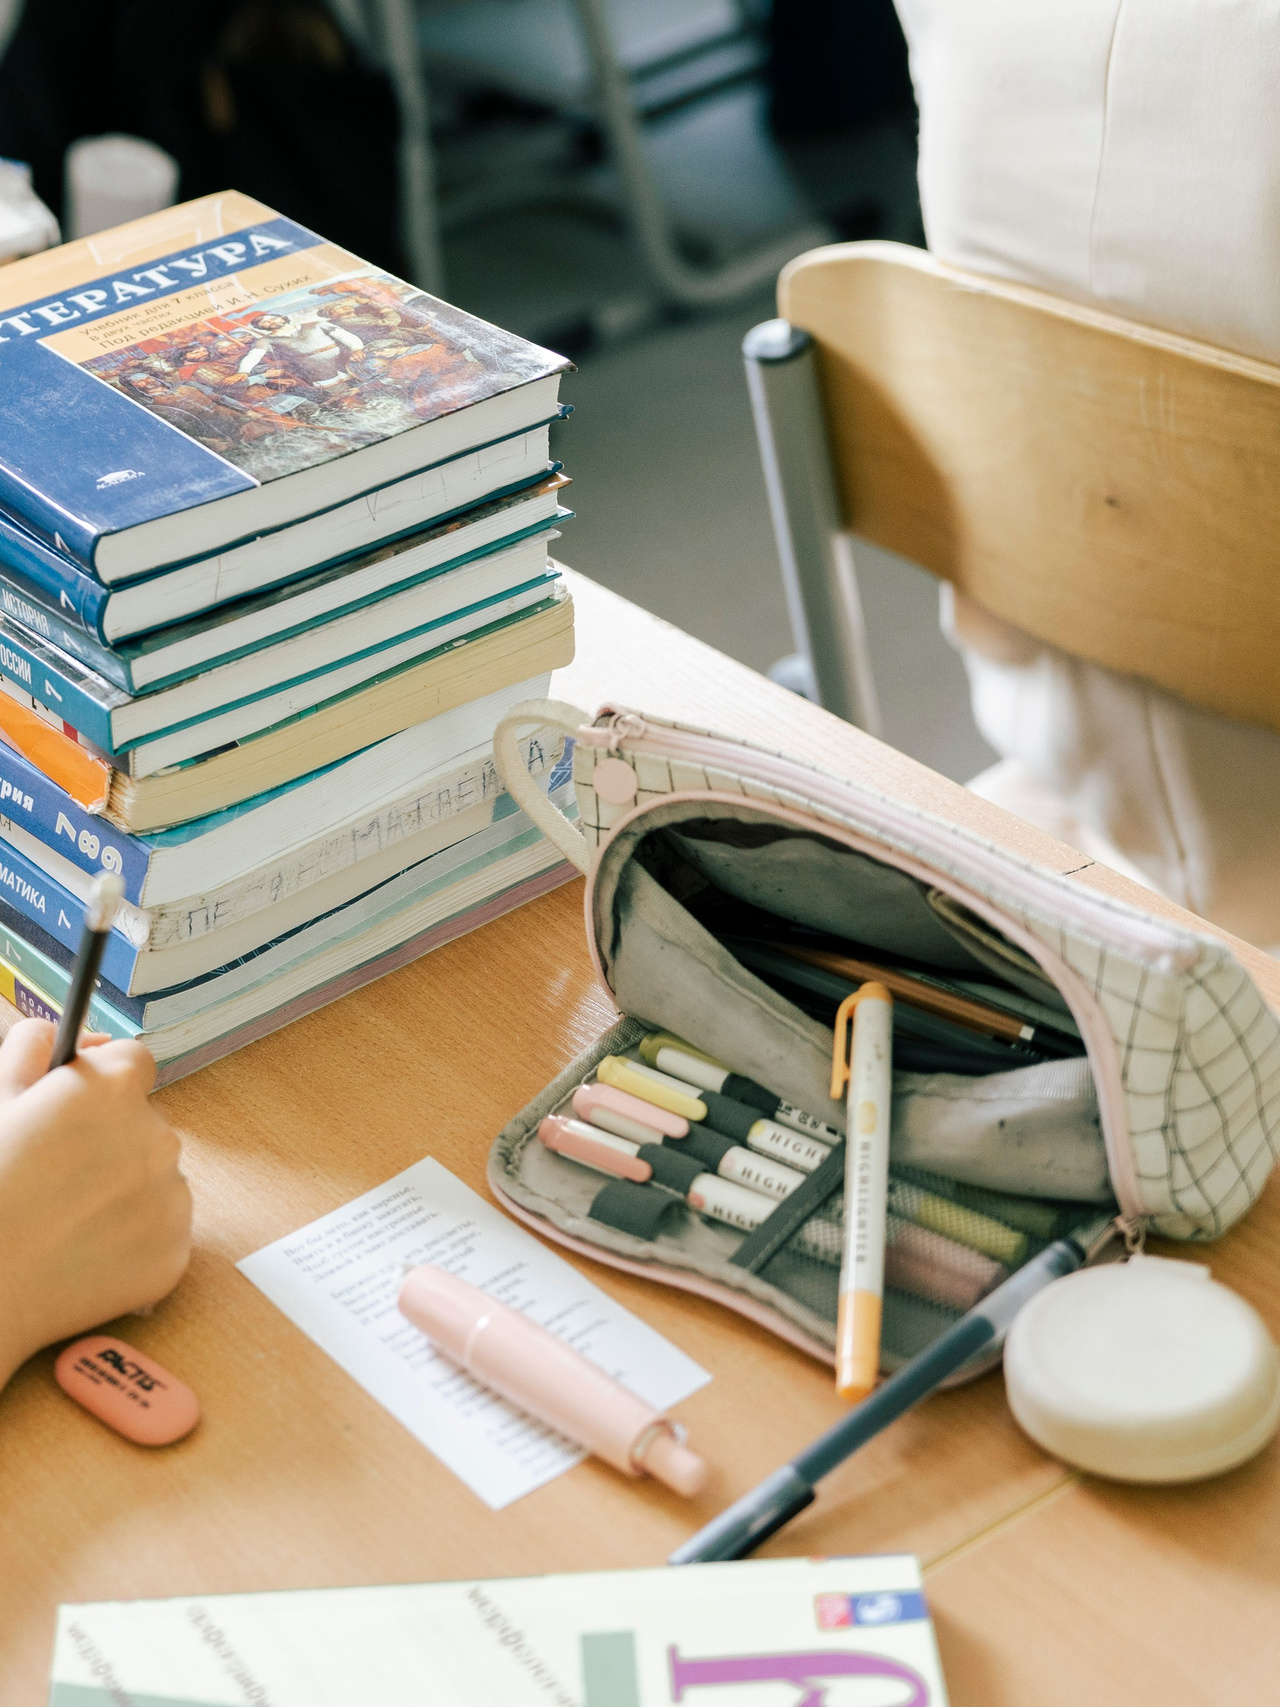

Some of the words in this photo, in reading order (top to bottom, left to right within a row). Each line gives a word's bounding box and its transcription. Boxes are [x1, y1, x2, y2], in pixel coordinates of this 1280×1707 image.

[78, 312, 141, 337] Учебник
[143, 303, 170, 316] для
[186, 280, 234, 300] класса
[99, 334, 136, 350] Под
[139, 302, 225, 337] редакцией
[226, 294, 243, 306] И.
[245, 289, 261, 299] Н.
[263, 274, 313, 293] Сухих
[88, 333, 101, 342] В
[104, 325, 126, 338] двух
[128, 311, 173, 331] частях
[60, 590, 76, 612] 7
[2, 588, 50, 636] ИСТОРИЯ
[63, 630, 82, 653] 7
[45, 679, 63, 702] 7
[57, 909, 72, 930] 7
[5, 940, 21, 962] 7
